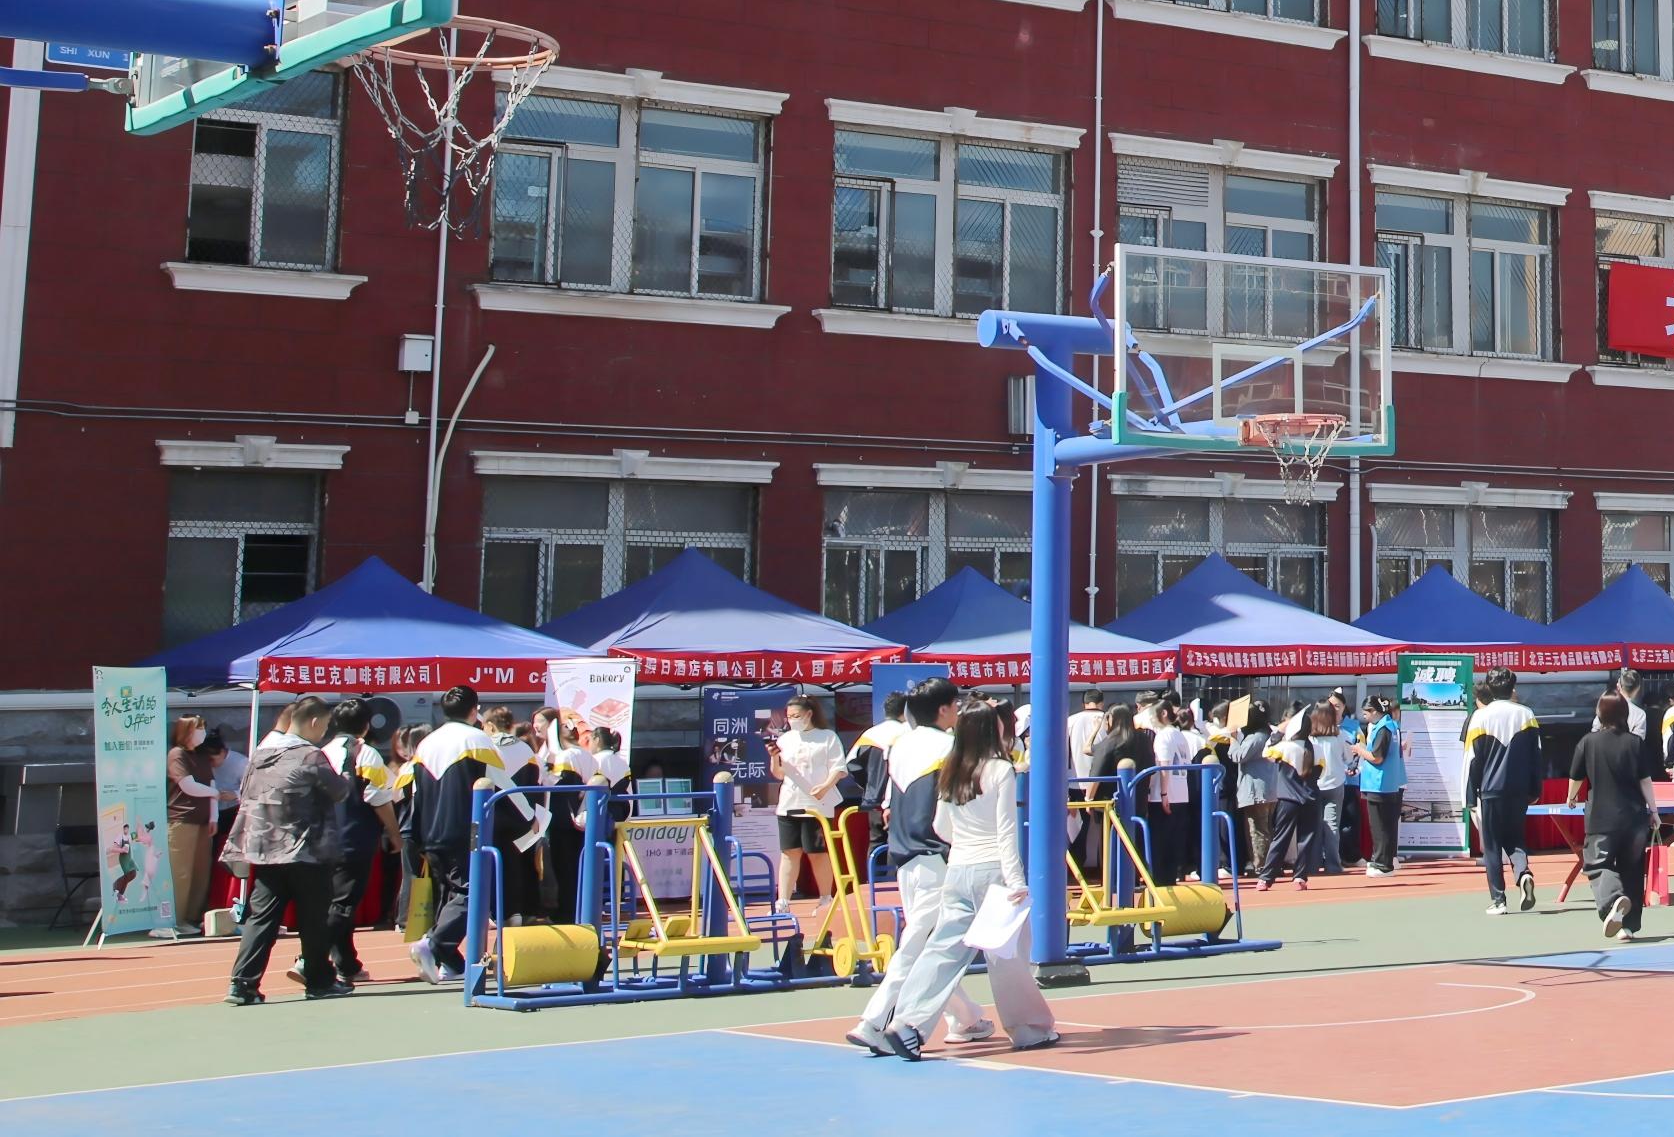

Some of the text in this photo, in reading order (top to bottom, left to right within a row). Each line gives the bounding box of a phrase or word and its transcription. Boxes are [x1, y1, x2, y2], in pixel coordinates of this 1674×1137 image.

[58, 46, 110, 59] SHI XUN
[268, 664, 430, 686] 北京星巴克咖啡有限公司
[617, 655, 756, 678] 假日酒店有限公司
[730, 762, 766, 778] 无际
